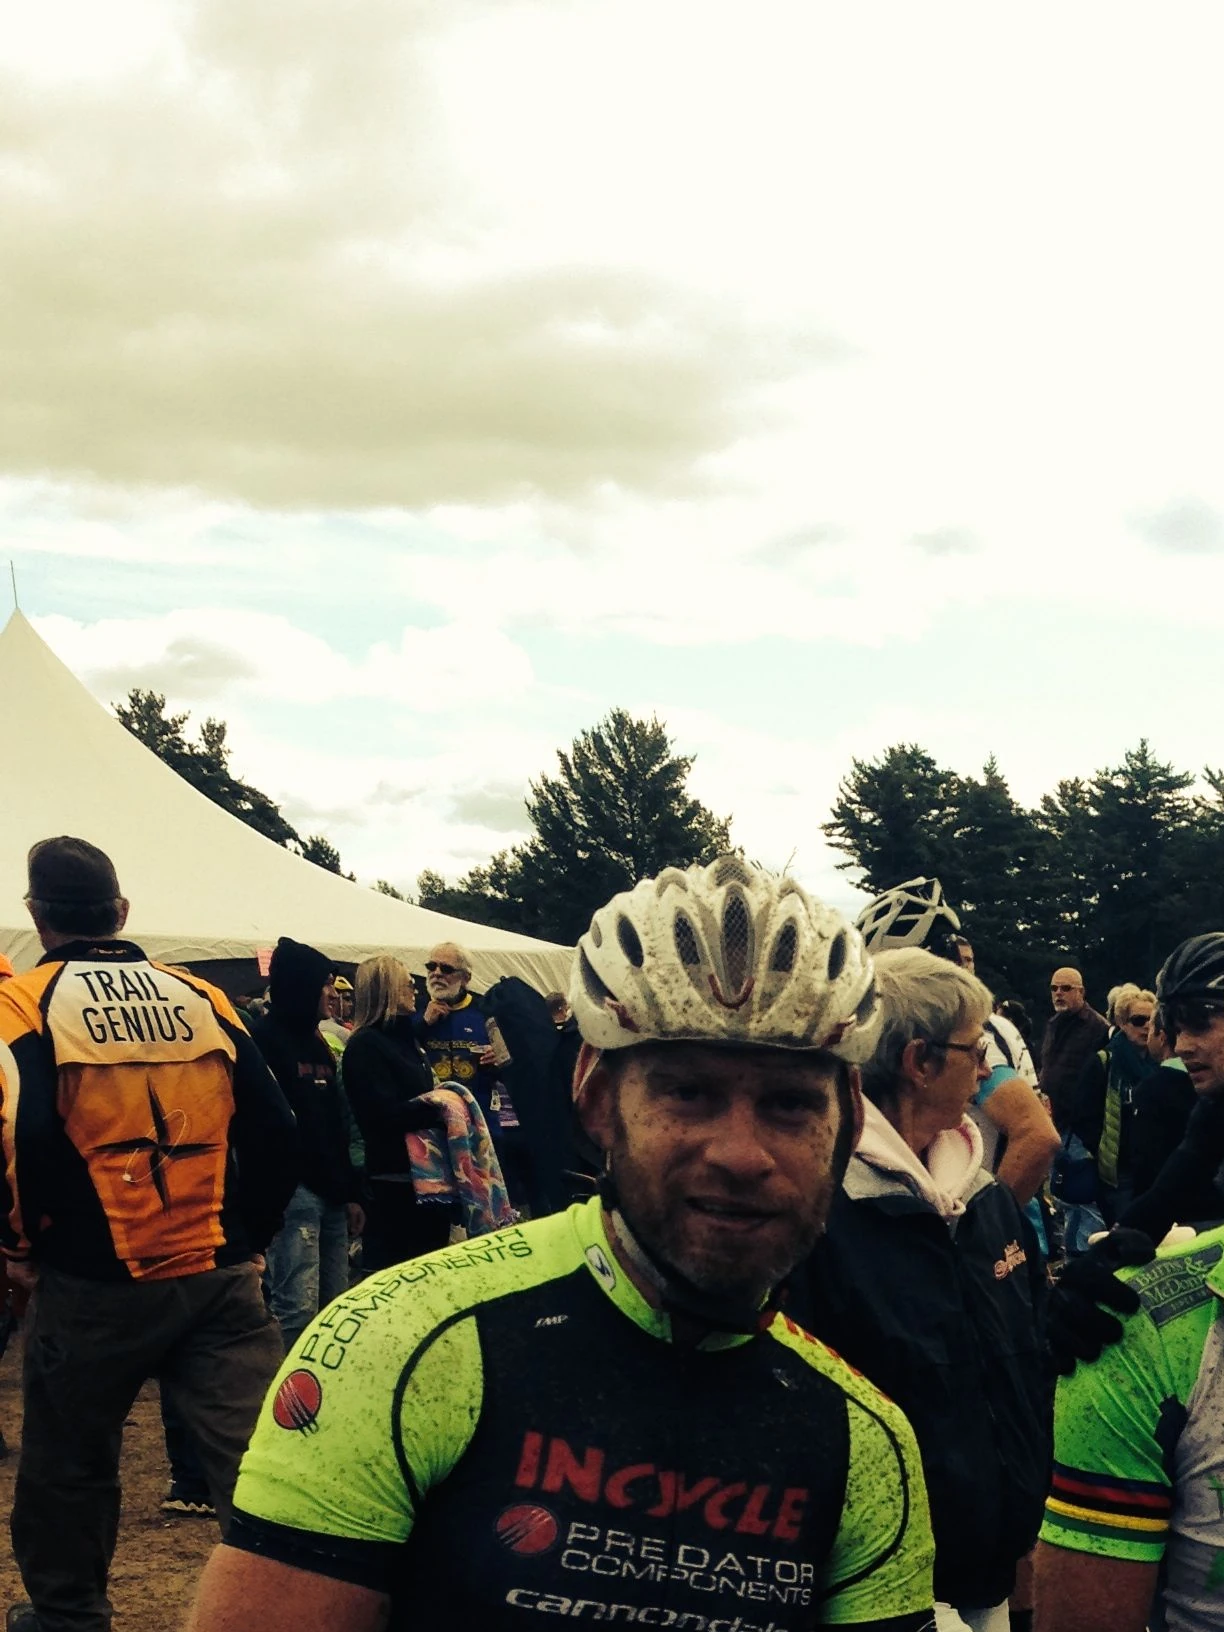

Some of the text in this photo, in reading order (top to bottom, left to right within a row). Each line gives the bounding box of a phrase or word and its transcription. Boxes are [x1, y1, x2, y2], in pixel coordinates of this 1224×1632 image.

[74, 969, 169, 1002] TRAIL
[82, 1005, 194, 1044] GENIUS
[320, 1240, 533, 1370] COMPONENTS
[514, 1428, 811, 1543] INCYCLE
[560, 1548, 814, 1607] COMPONENTS
[565, 1520, 815, 1586] PREDATOR
